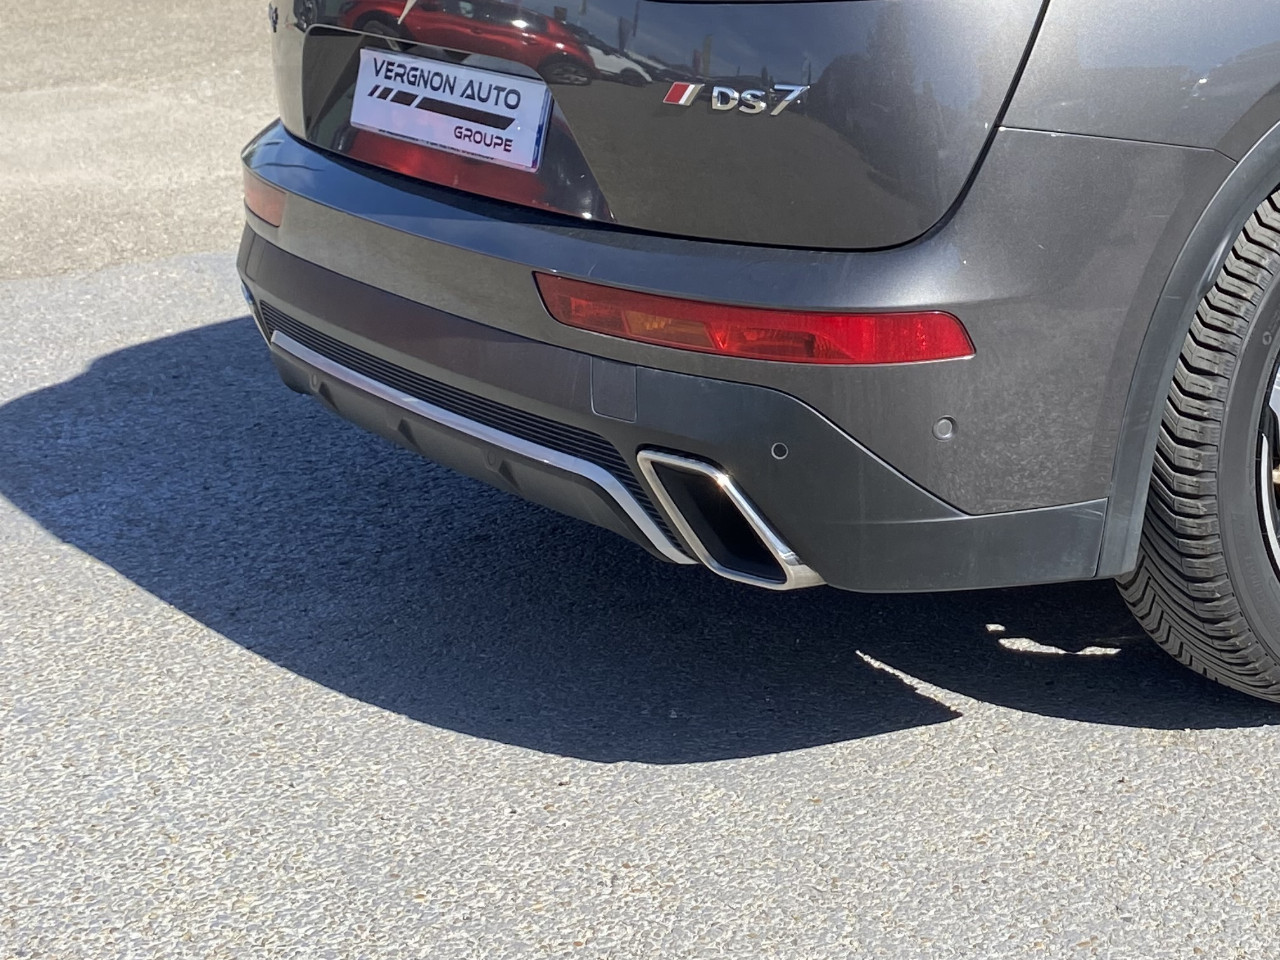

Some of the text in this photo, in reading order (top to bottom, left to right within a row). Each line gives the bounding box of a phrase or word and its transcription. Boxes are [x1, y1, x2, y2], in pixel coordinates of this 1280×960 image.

[373, 57, 521, 111] VERGNON AUTO
[453, 126, 513, 153] GROUPE
